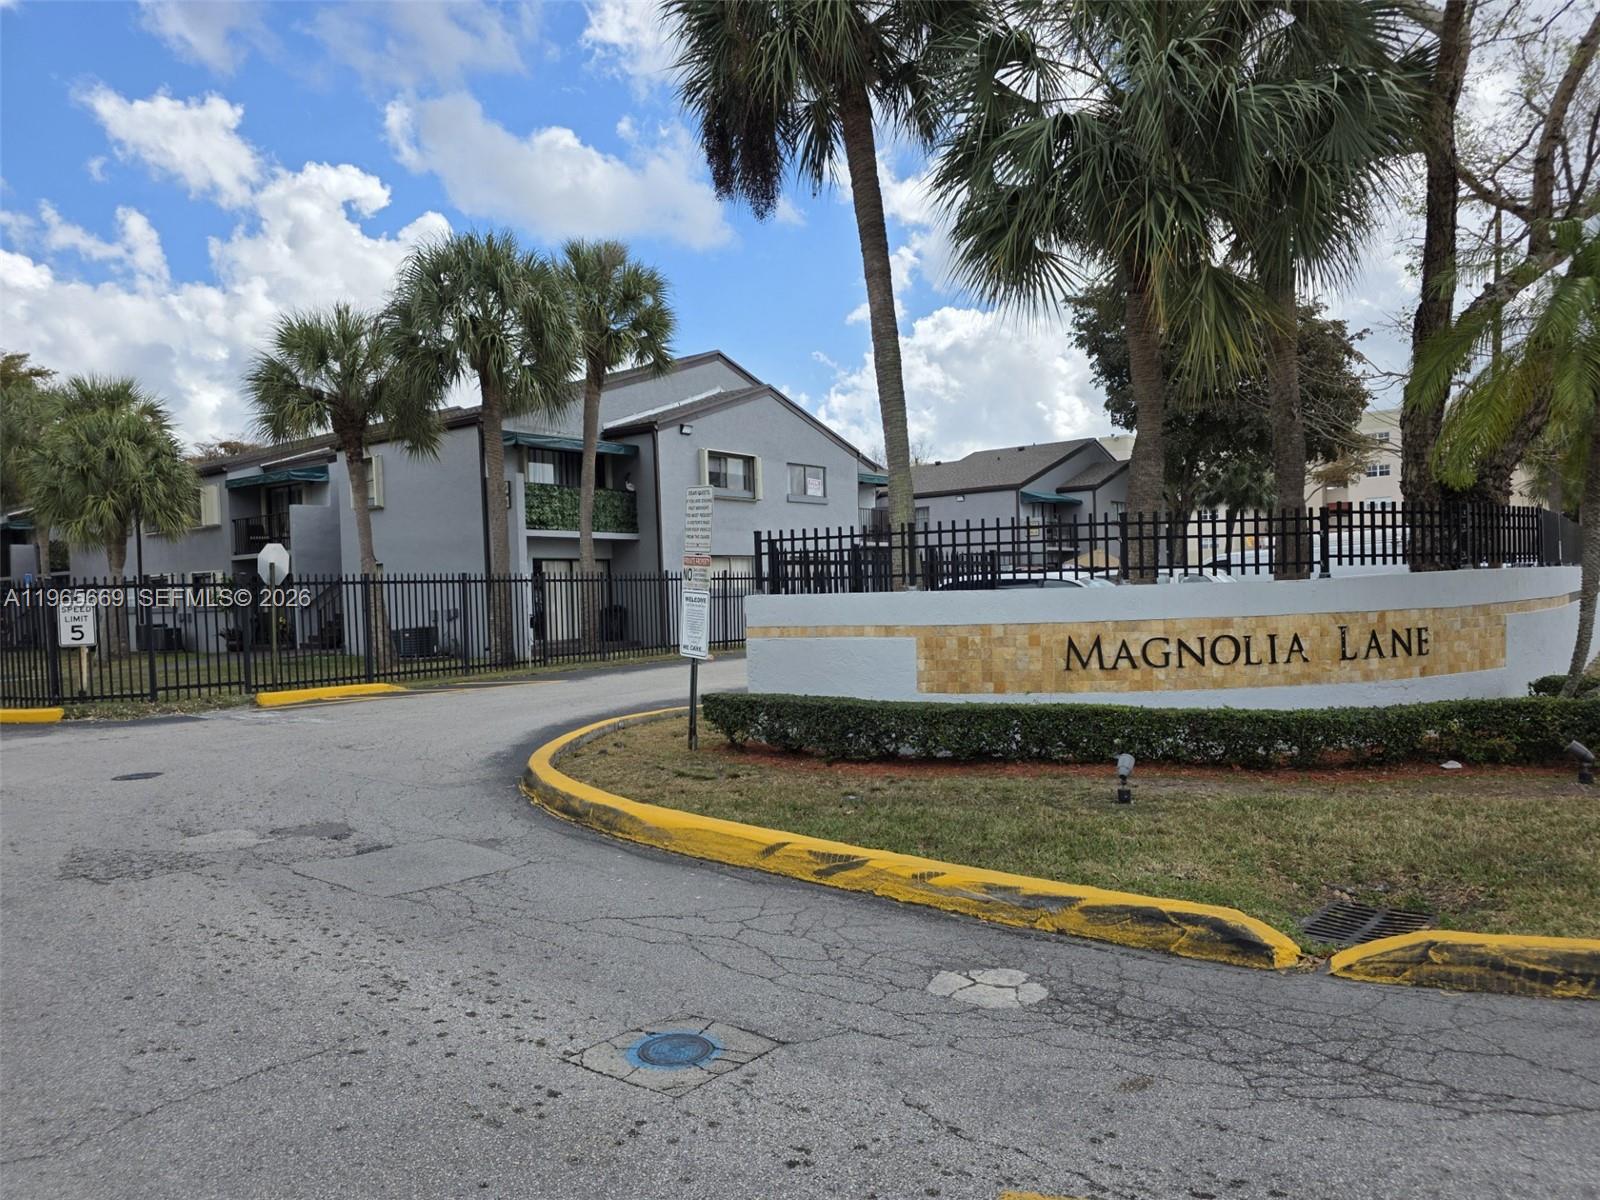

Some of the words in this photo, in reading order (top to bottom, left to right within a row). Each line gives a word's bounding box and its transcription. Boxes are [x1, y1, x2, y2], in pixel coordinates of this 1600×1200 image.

[683, 567, 692, 581] NO
[64, 615, 88, 623] LIMIT
[71, 625, 84, 641] 5
[1064, 632, 1310, 671] MAGNOLIA
[1338, 625, 1431, 661] LANE
